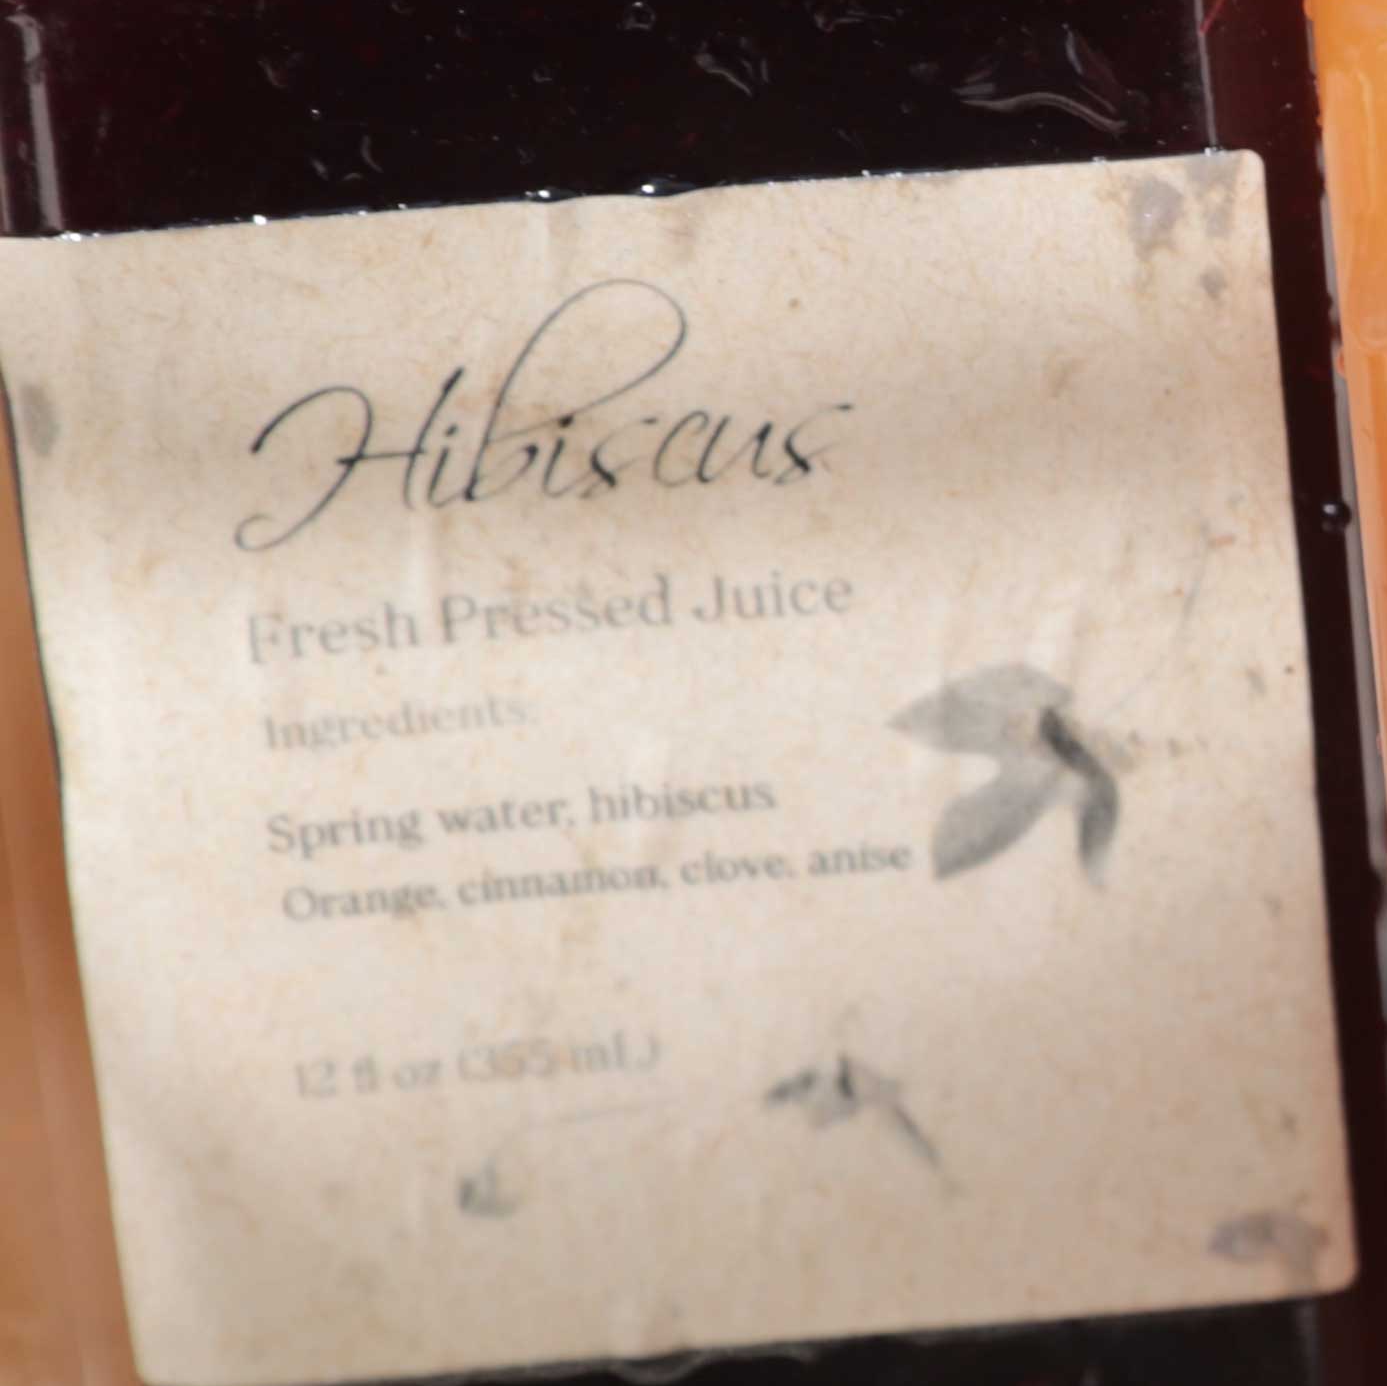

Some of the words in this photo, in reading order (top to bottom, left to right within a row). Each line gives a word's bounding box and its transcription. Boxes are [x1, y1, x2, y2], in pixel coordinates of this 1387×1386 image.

[234, 278, 854, 551] Hibiscus
[248, 602, 420, 665] Fresh
[440, 573, 674, 646] Pressed
[690, 570, 854, 622] Juice
[266, 808, 424, 861] Spring
[436, 791, 576, 835] water,
[588, 777, 777, 827] hibiscus
[282, 878, 443, 923] Orange,
[808, 843, 913, 876] anise
